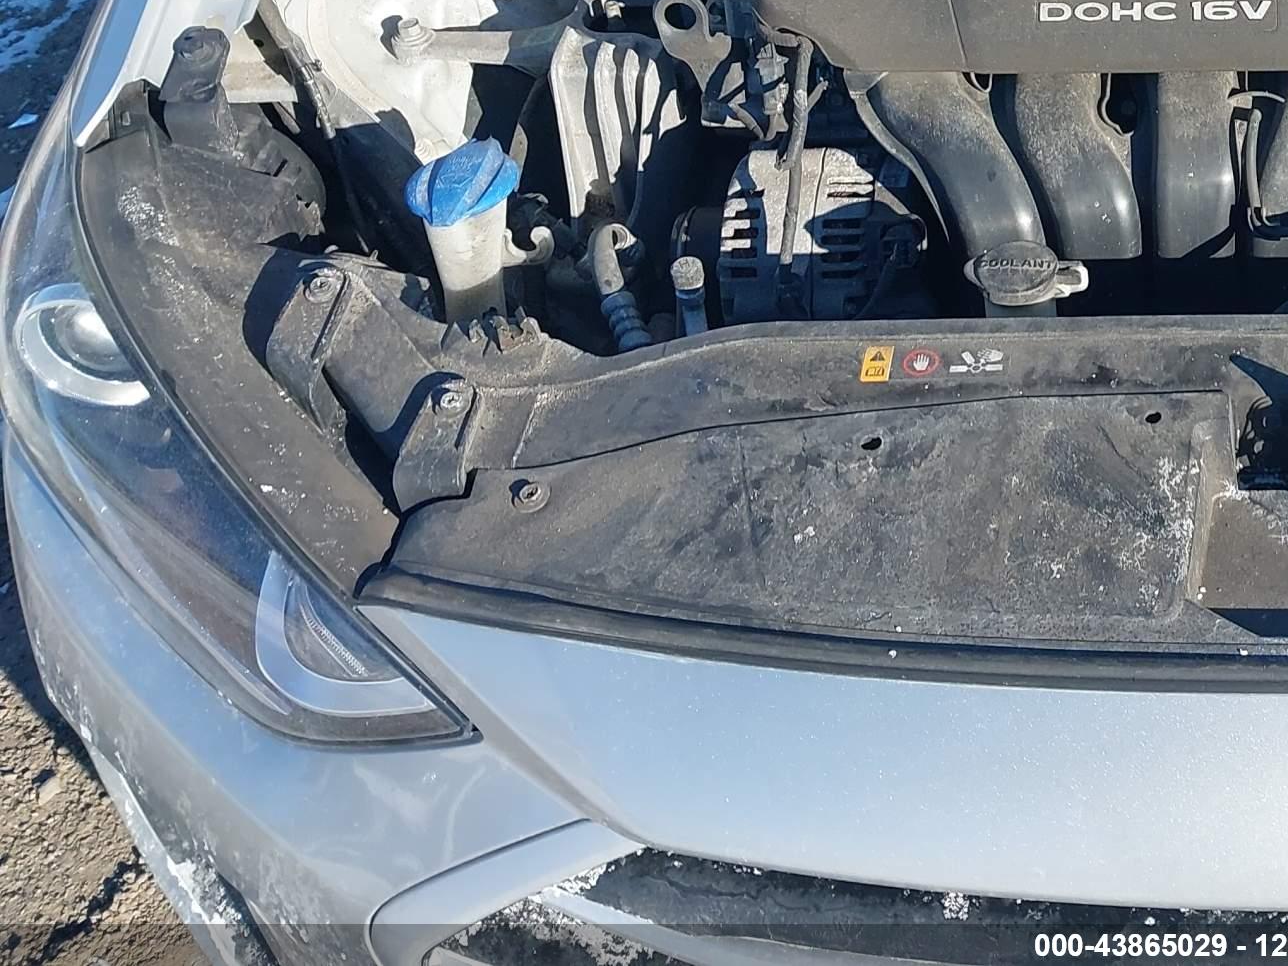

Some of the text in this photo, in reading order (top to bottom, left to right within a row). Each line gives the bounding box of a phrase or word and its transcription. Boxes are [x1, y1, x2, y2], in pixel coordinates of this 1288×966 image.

[1038, 0, 1272, 22] DOHC 16V
[980, 257, 1053, 269] COOLANT
